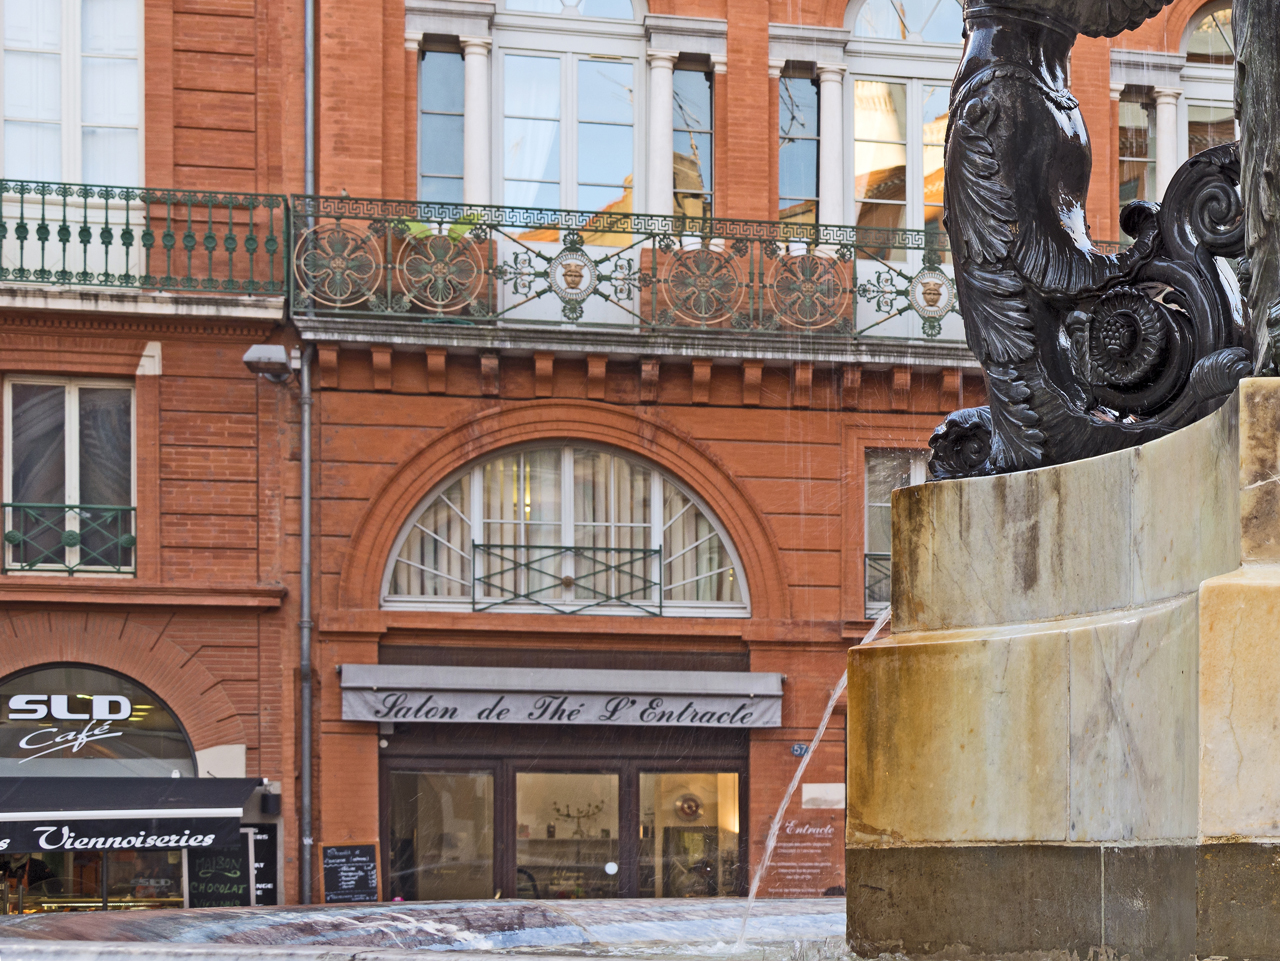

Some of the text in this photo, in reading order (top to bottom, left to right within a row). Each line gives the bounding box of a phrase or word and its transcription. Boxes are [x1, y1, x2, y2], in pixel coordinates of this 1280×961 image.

[9, 694, 131, 720] SLD
[375, 692, 459, 720] Salon
[477, 695, 511, 721] de
[528, 695, 585, 722] Thé
[19, 720, 113, 753] Café
[793, 744, 807, 755] 57
[33, 825, 216, 850] Viennoiseries
[190, 881, 247, 894] CHOCOLAT
